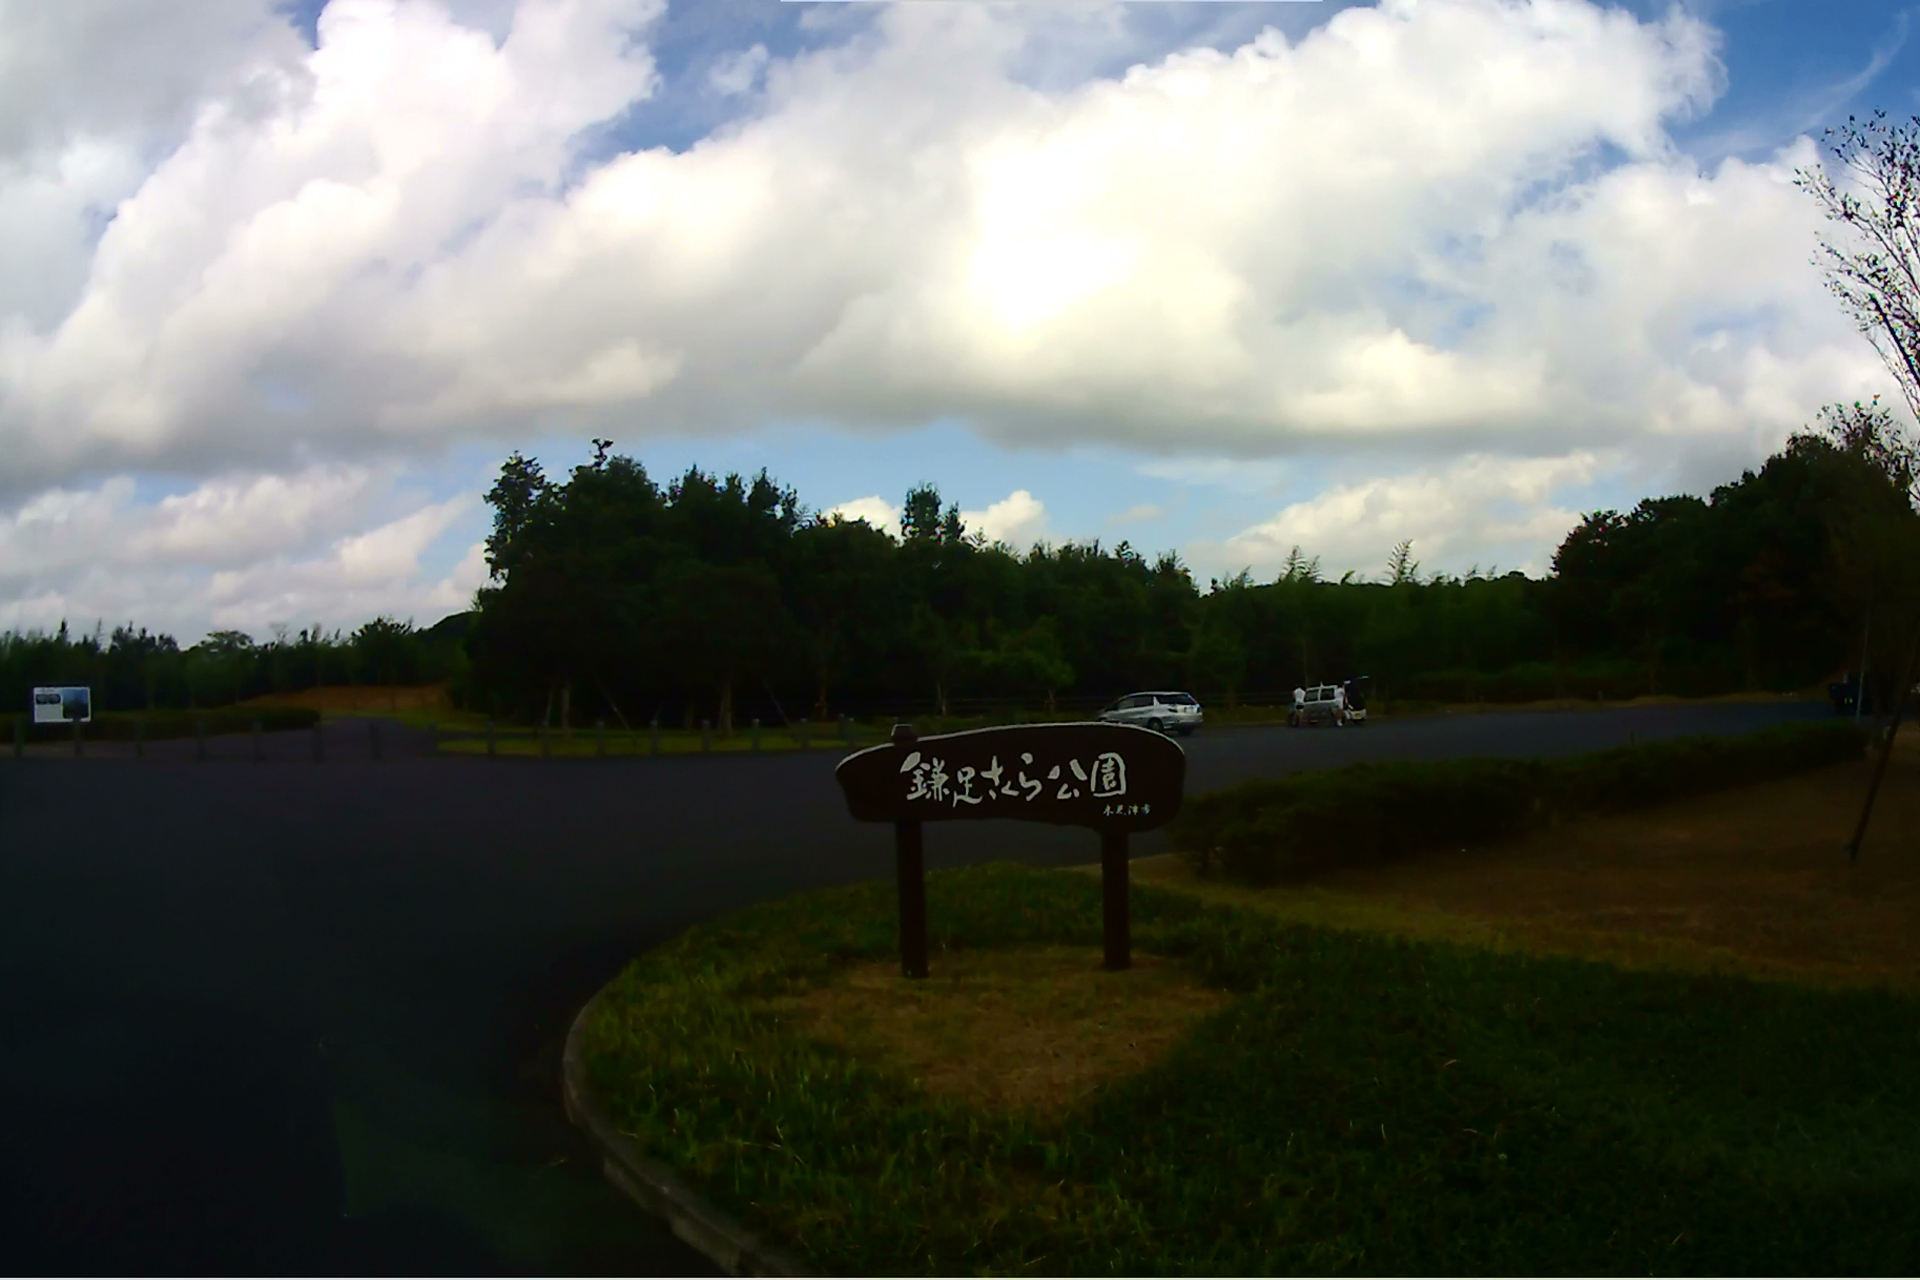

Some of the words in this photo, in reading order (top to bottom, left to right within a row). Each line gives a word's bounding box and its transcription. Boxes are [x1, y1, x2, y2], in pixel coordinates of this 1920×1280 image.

[900, 751, 1127, 807] 鎌足さくら公園
